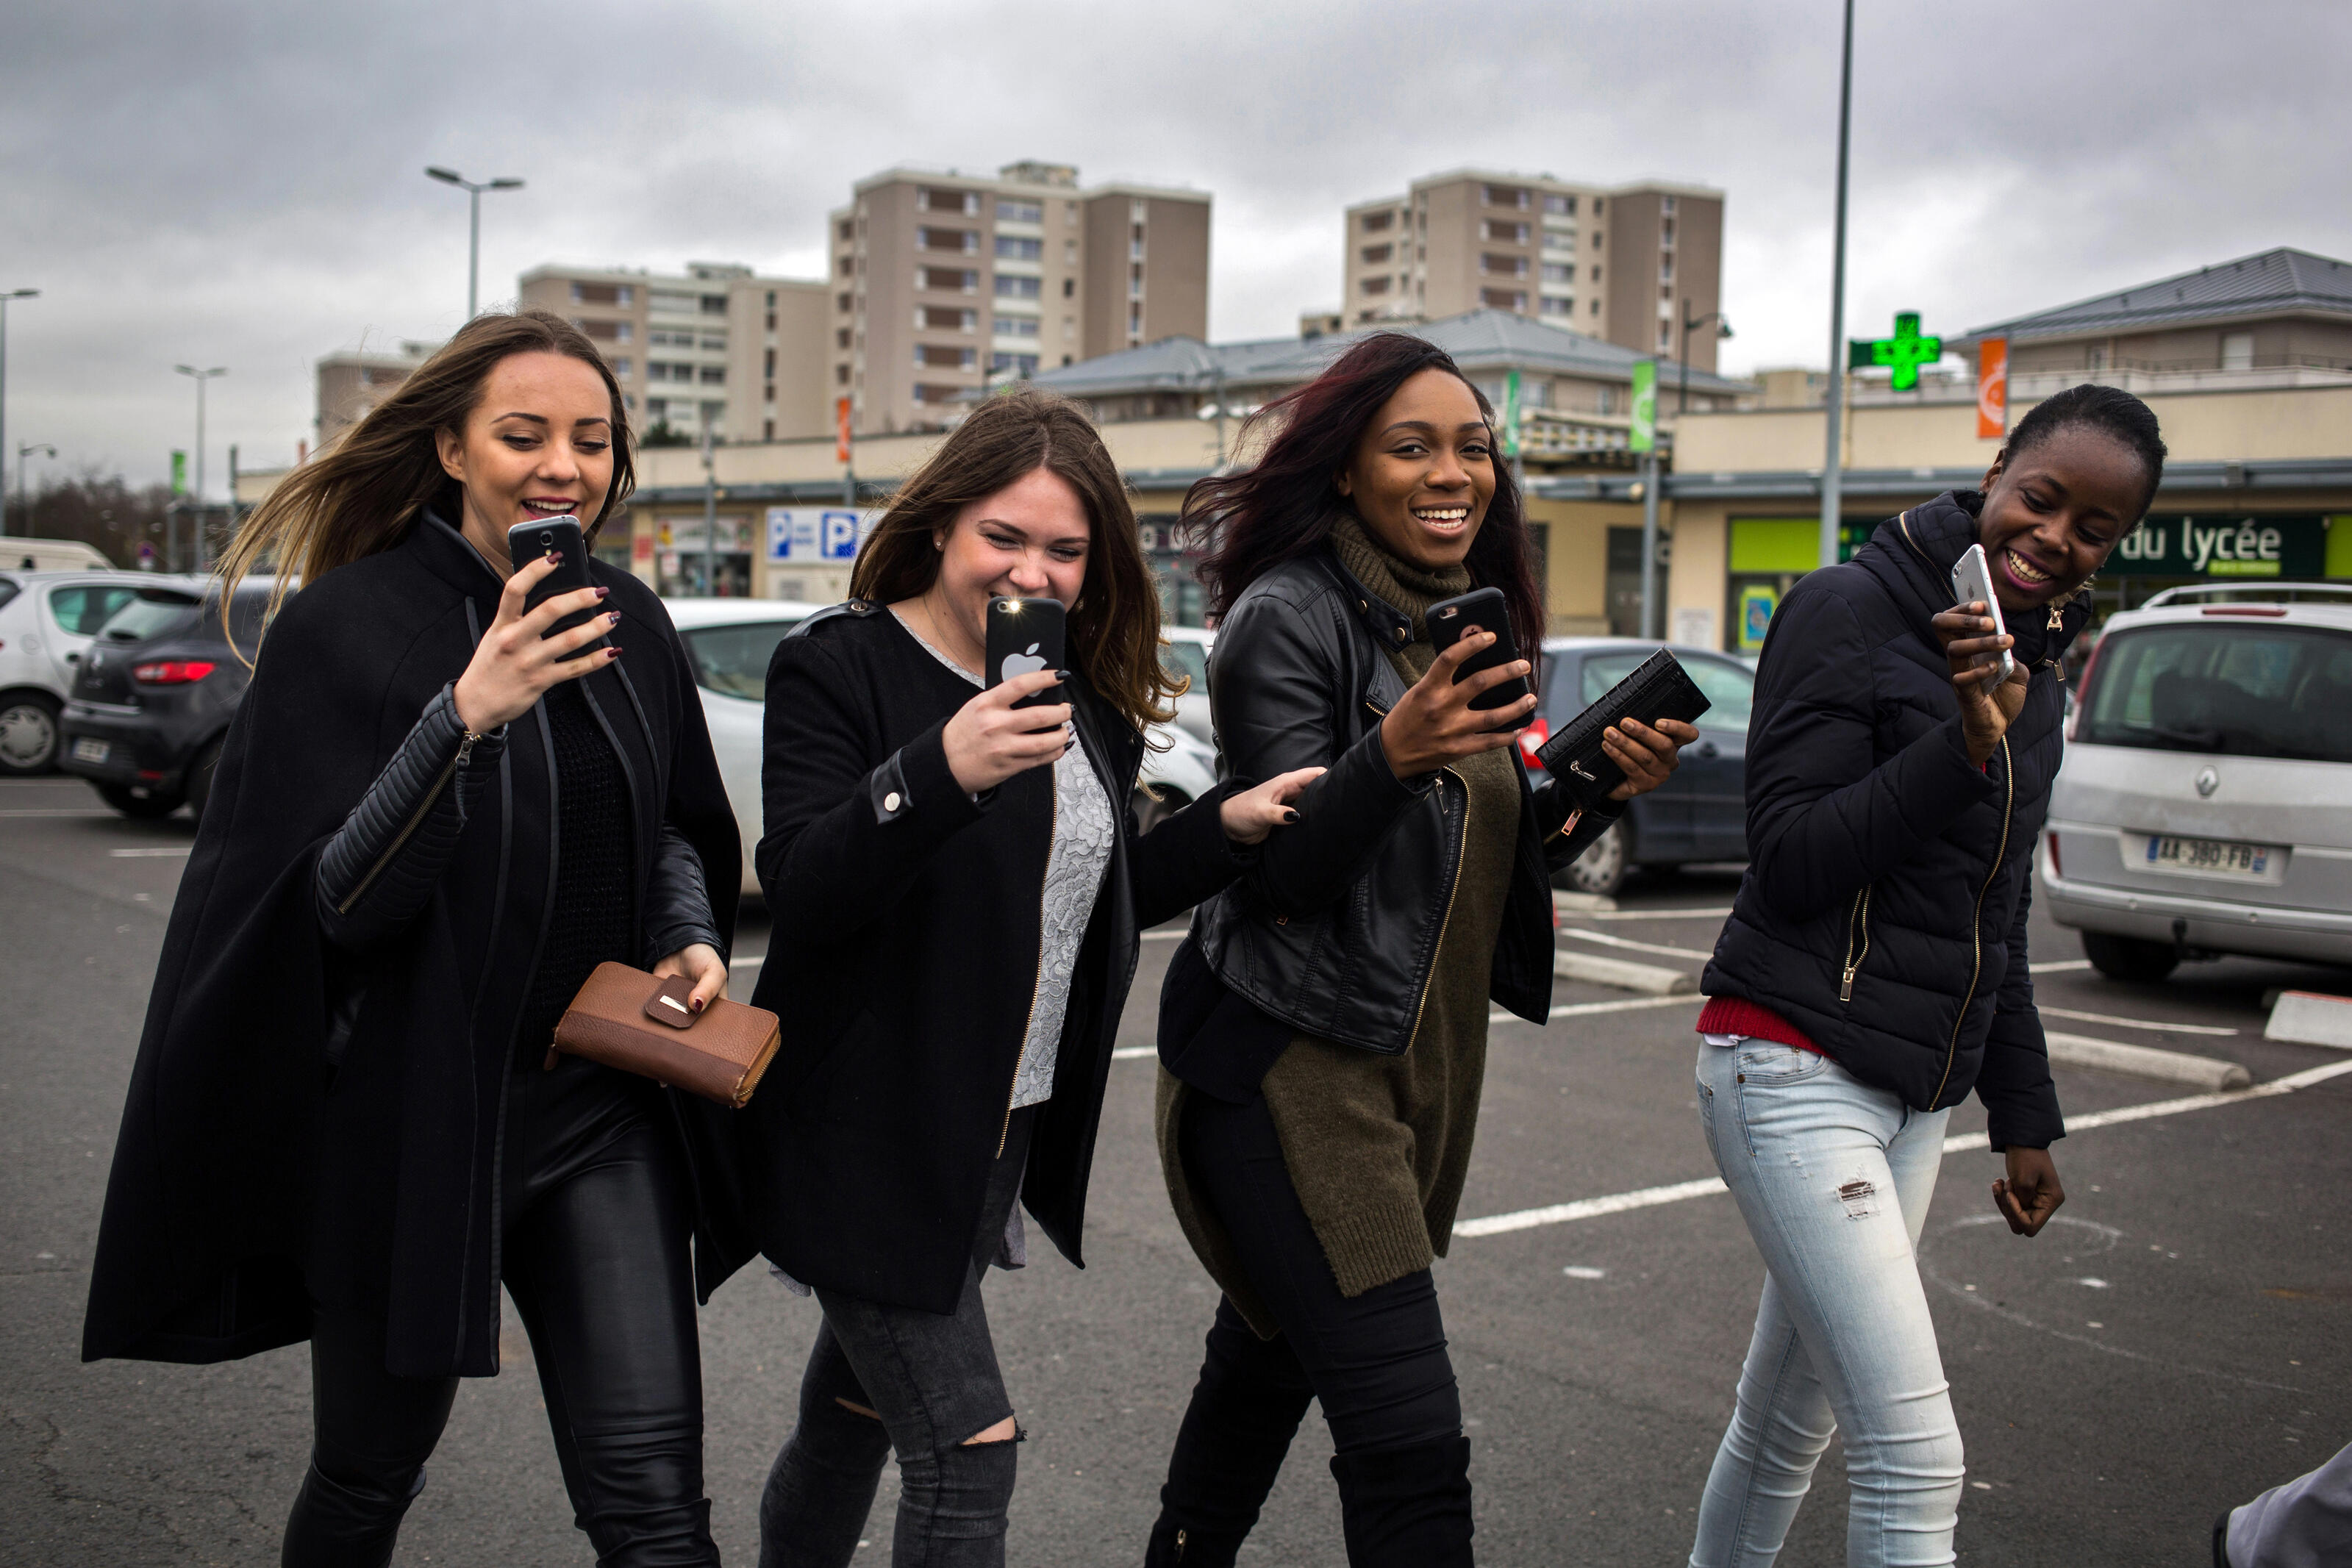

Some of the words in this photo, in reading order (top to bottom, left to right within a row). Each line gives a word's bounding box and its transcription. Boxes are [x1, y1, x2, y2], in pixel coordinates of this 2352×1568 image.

[826, 518, 854, 555] P
[2120, 518, 2167, 559] du
[2181, 516, 2281, 571] lycée
